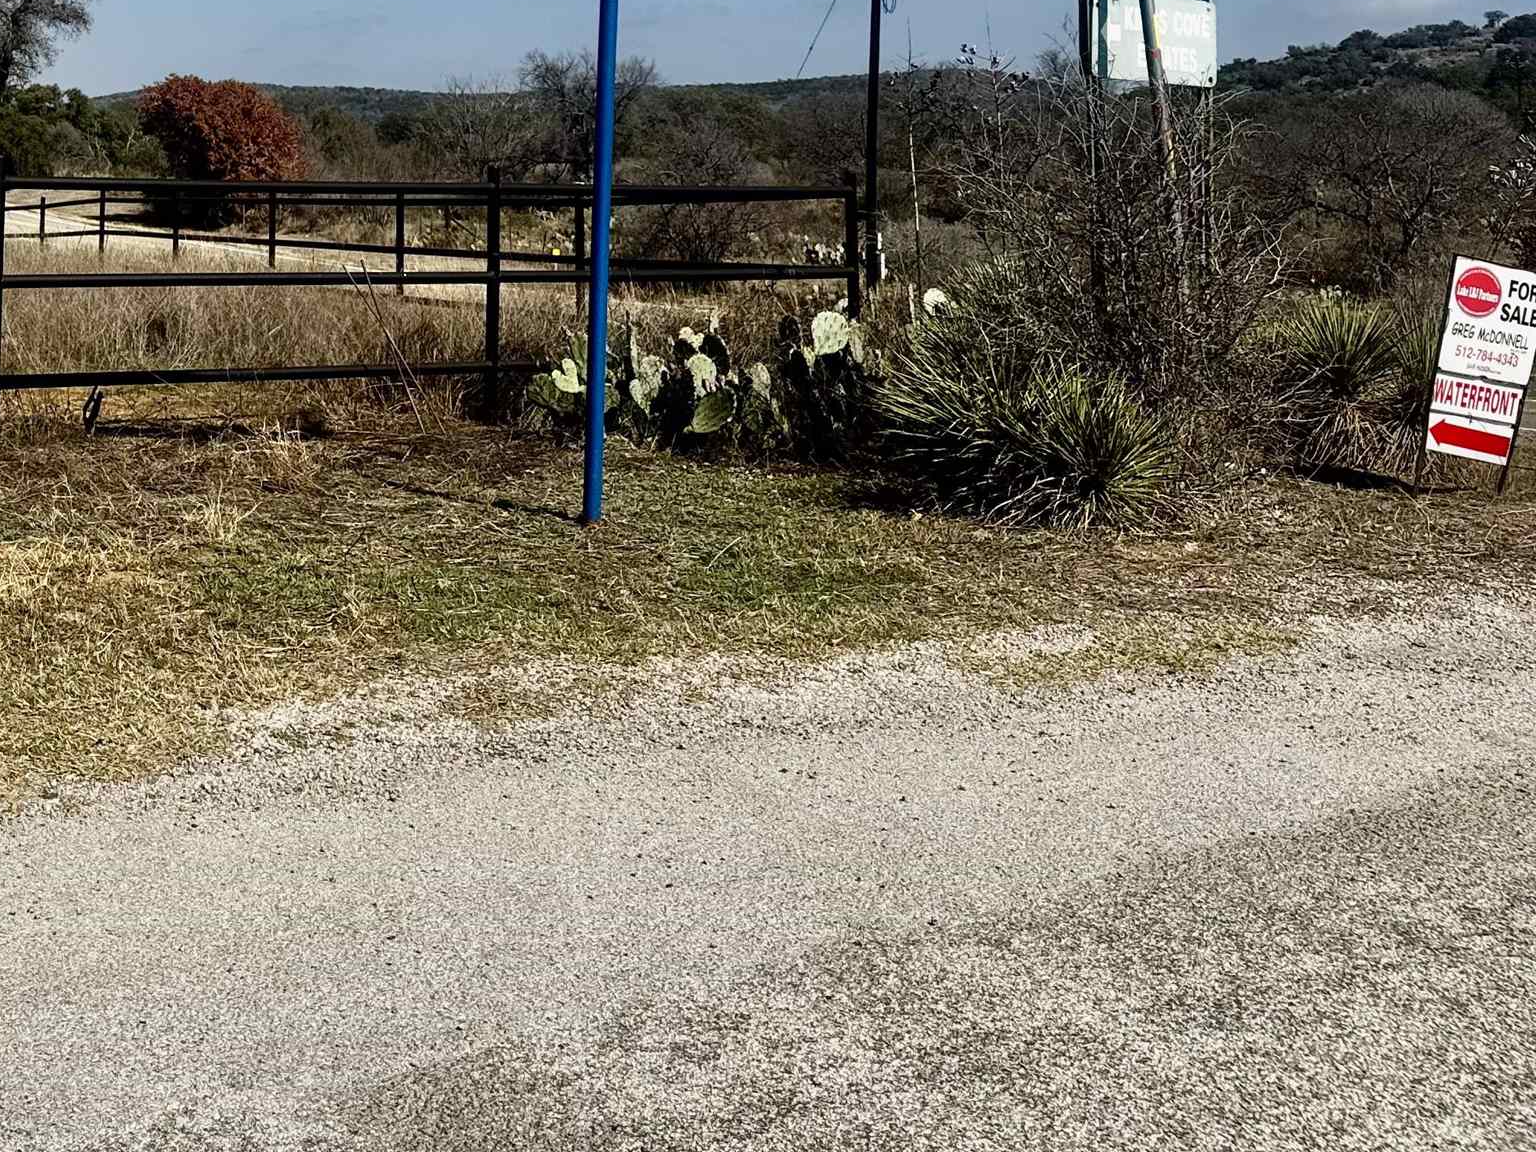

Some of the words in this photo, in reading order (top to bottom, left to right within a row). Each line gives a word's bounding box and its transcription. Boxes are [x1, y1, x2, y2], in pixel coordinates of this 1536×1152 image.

[1175, 10, 1213, 38] COVE
[1508, 279, 1536, 303] FOR
[1500, 303, 1536, 328] SALE
[1451, 322, 1476, 339] GREG
[1477, 327, 1528, 350] McDONNELL
[1455, 345, 1520, 368] 512-784-4343
[1434, 378, 1518, 417] WATERFRONT
